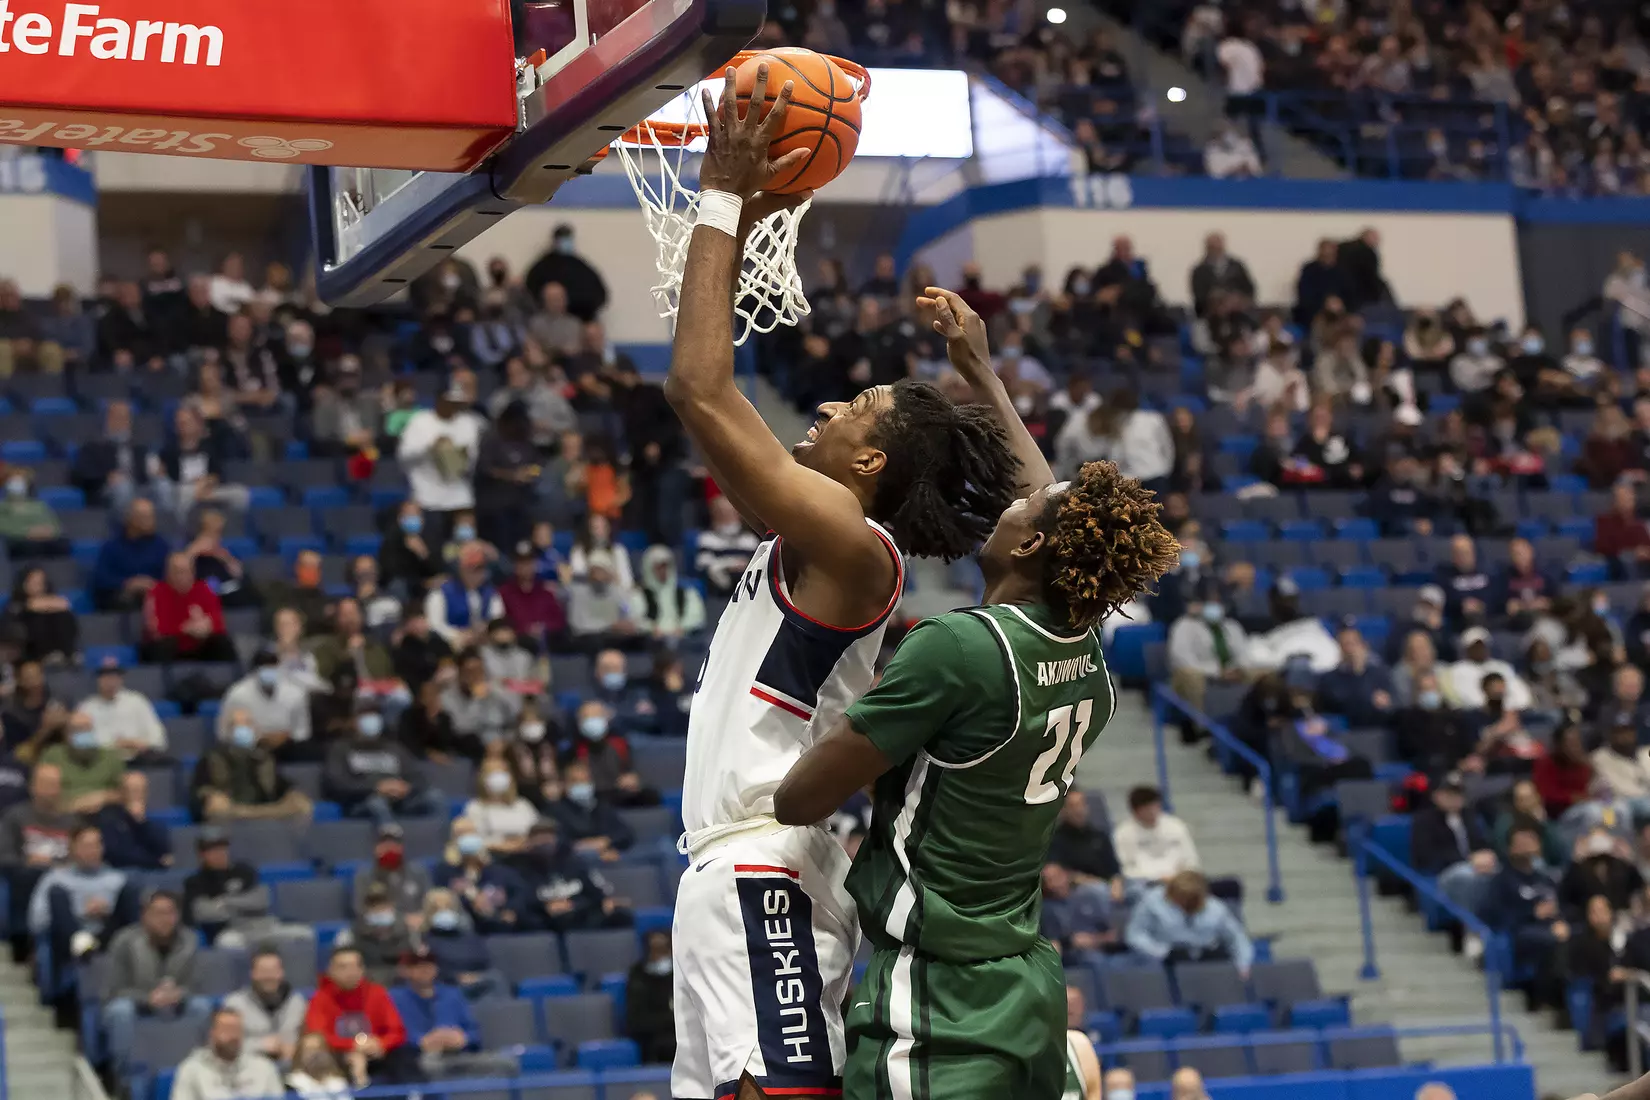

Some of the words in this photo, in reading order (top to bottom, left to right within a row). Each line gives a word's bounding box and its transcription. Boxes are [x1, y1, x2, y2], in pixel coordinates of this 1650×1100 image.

[58, 2, 224, 67] Farm
[54, 124, 233, 153] State
[1024, 699, 1094, 804] 21
[763, 889, 813, 1063] HUSKIES
